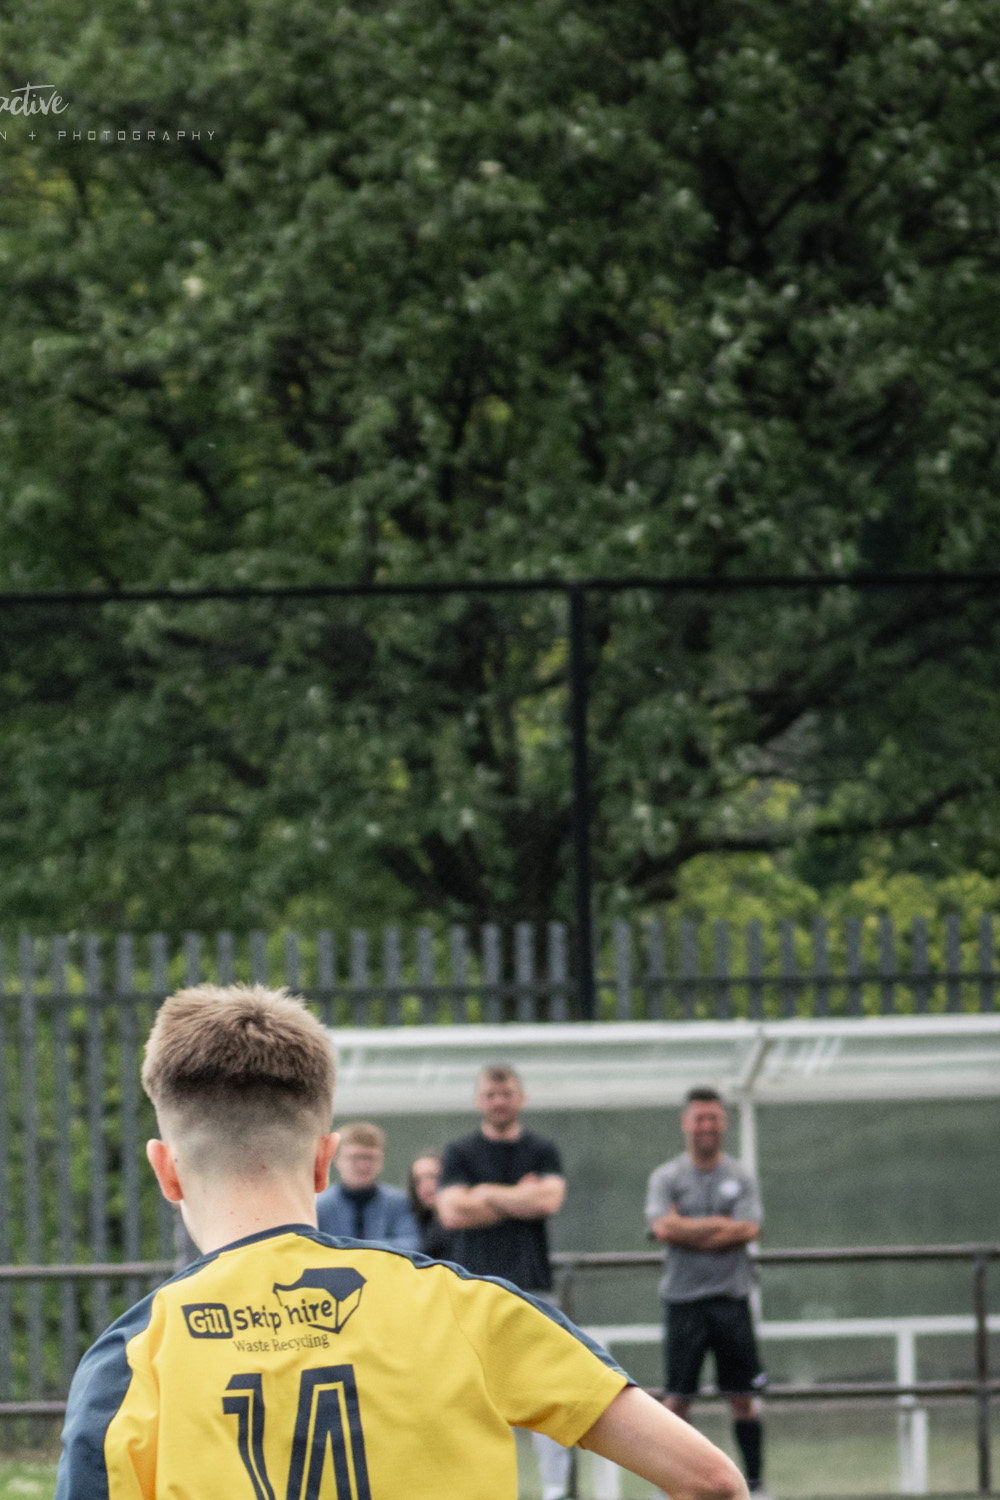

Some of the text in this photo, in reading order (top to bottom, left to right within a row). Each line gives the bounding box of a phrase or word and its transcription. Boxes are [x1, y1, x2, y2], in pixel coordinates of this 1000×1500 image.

[188, 1298, 333, 1335] Gill Skip hire
[233, 1333, 330, 1353] Waste Recycling
